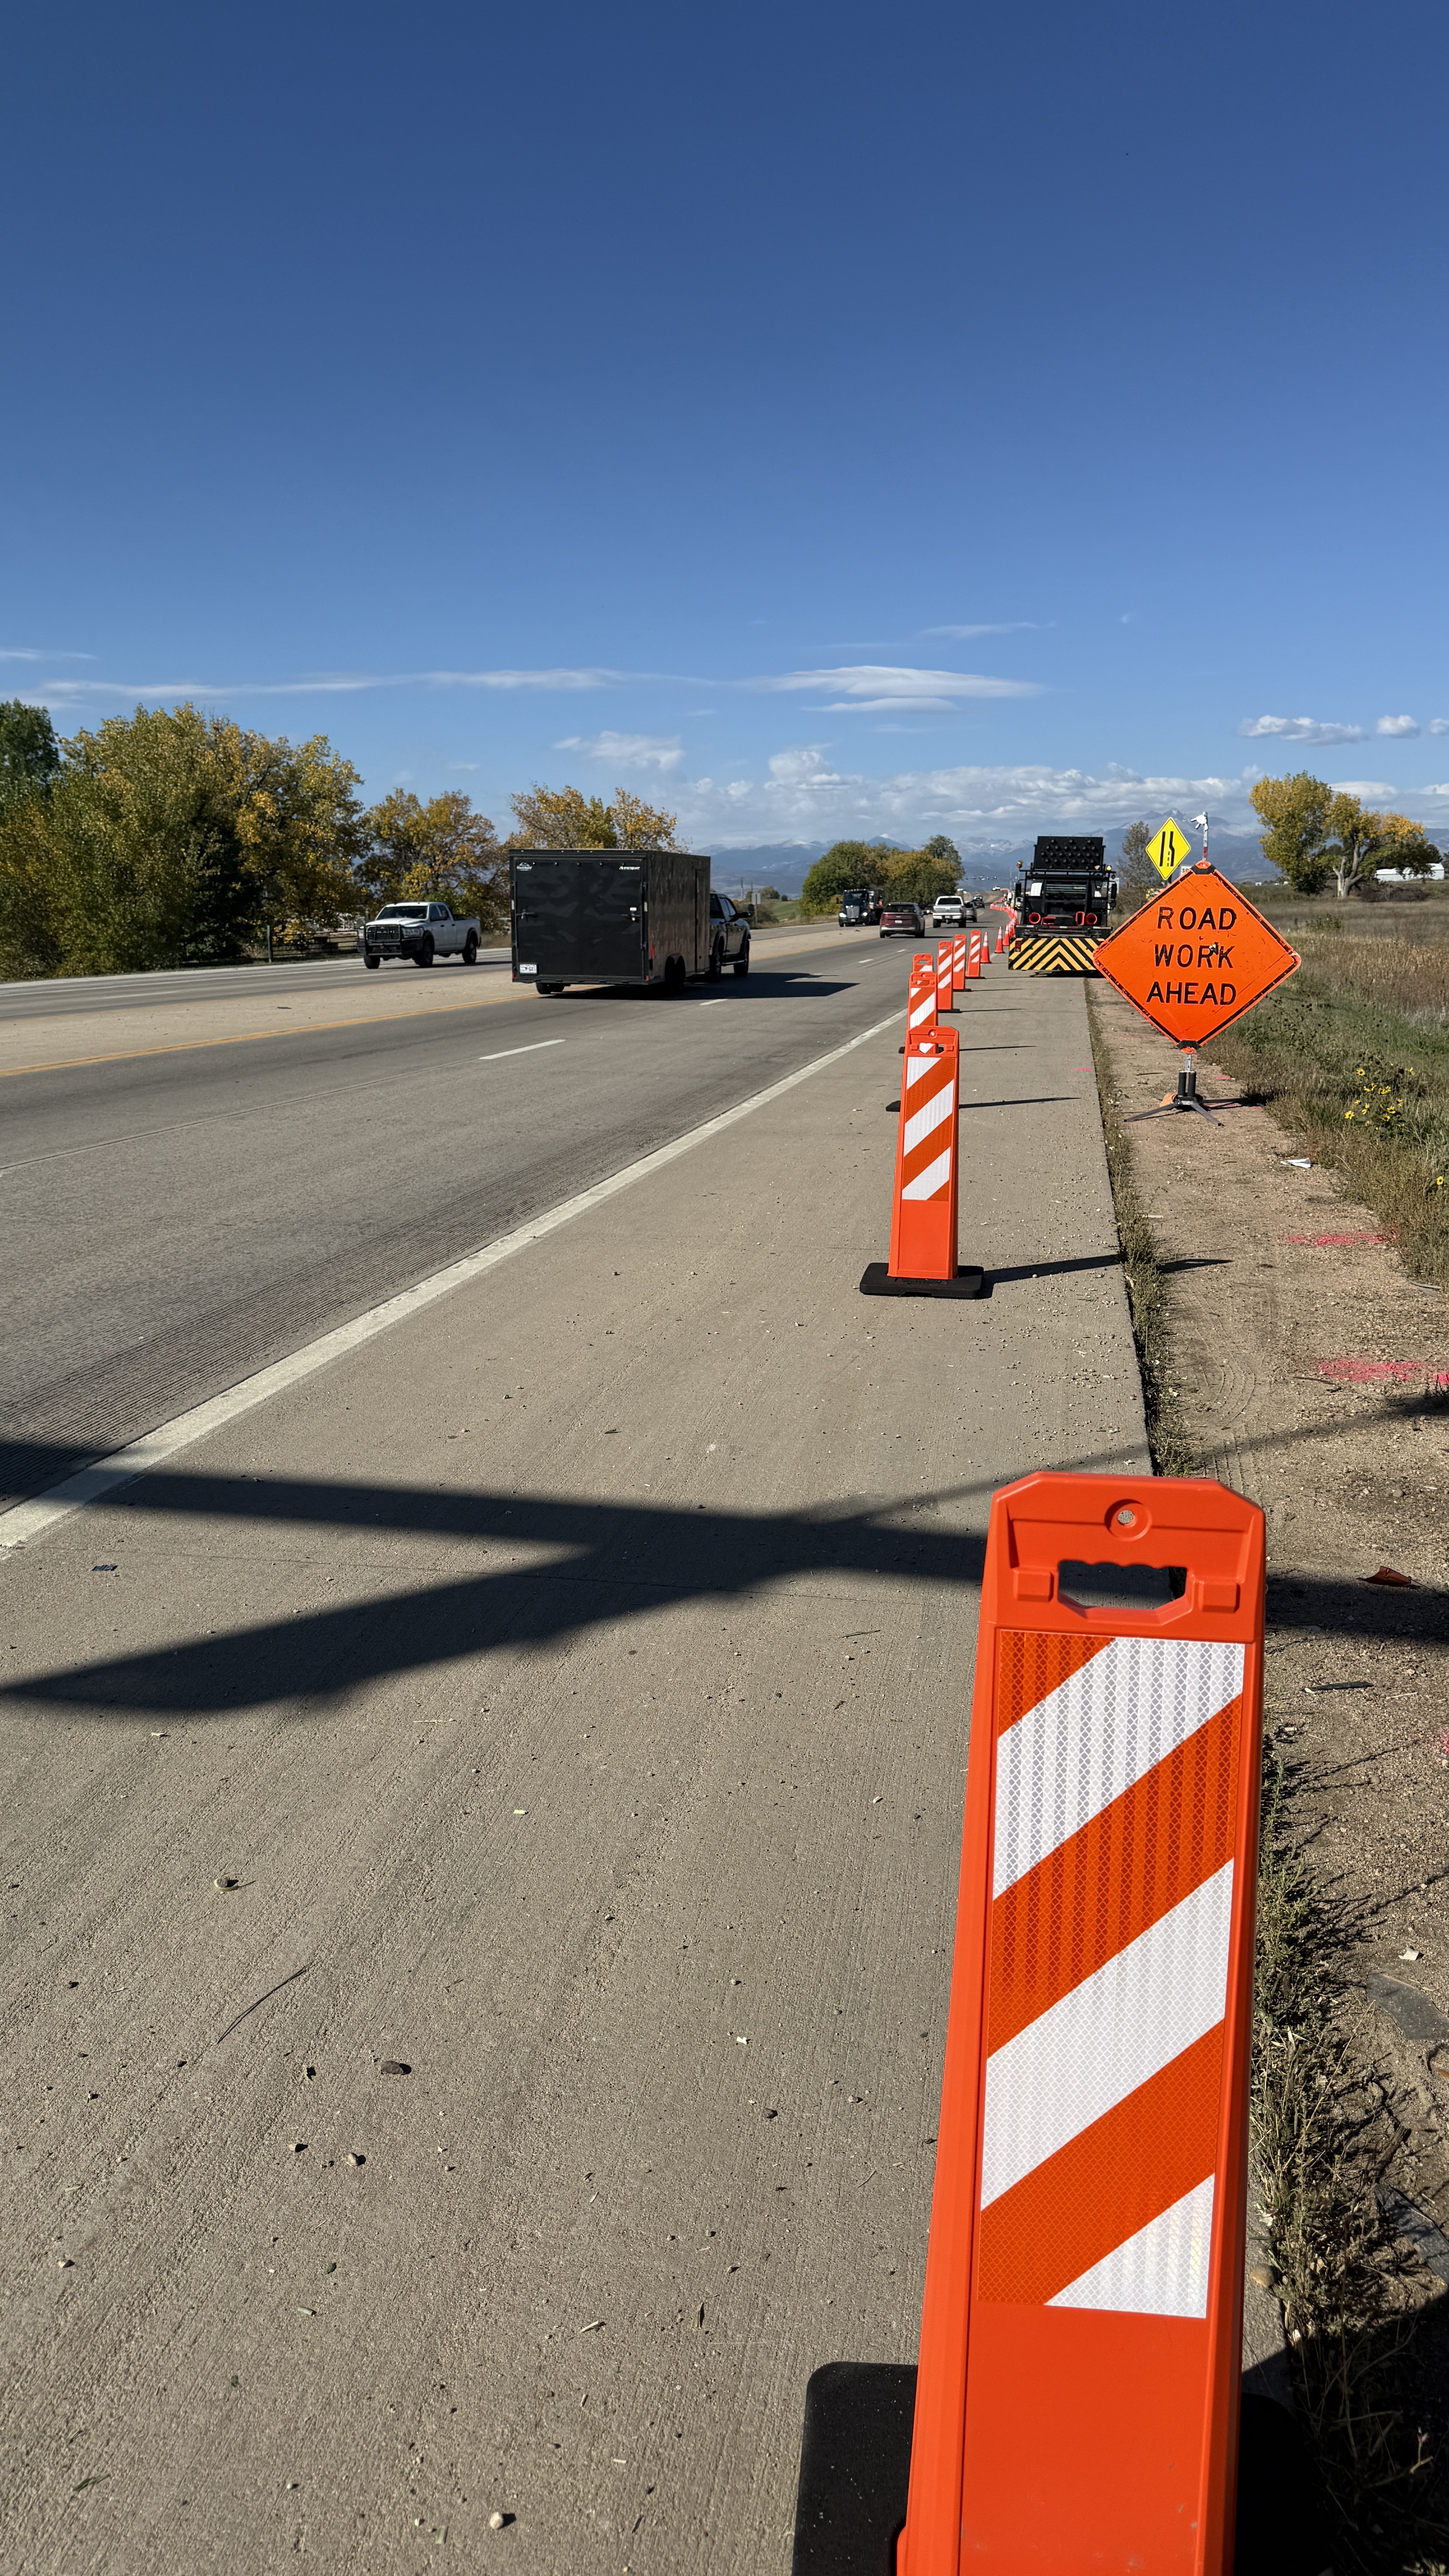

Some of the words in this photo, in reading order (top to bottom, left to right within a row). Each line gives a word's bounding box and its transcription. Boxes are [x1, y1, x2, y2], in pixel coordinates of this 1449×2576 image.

[1157, 906, 1237, 930] ROAD
[1155, 944, 1235, 969] WORK
[1146, 981, 1237, 1005] AHEAD
